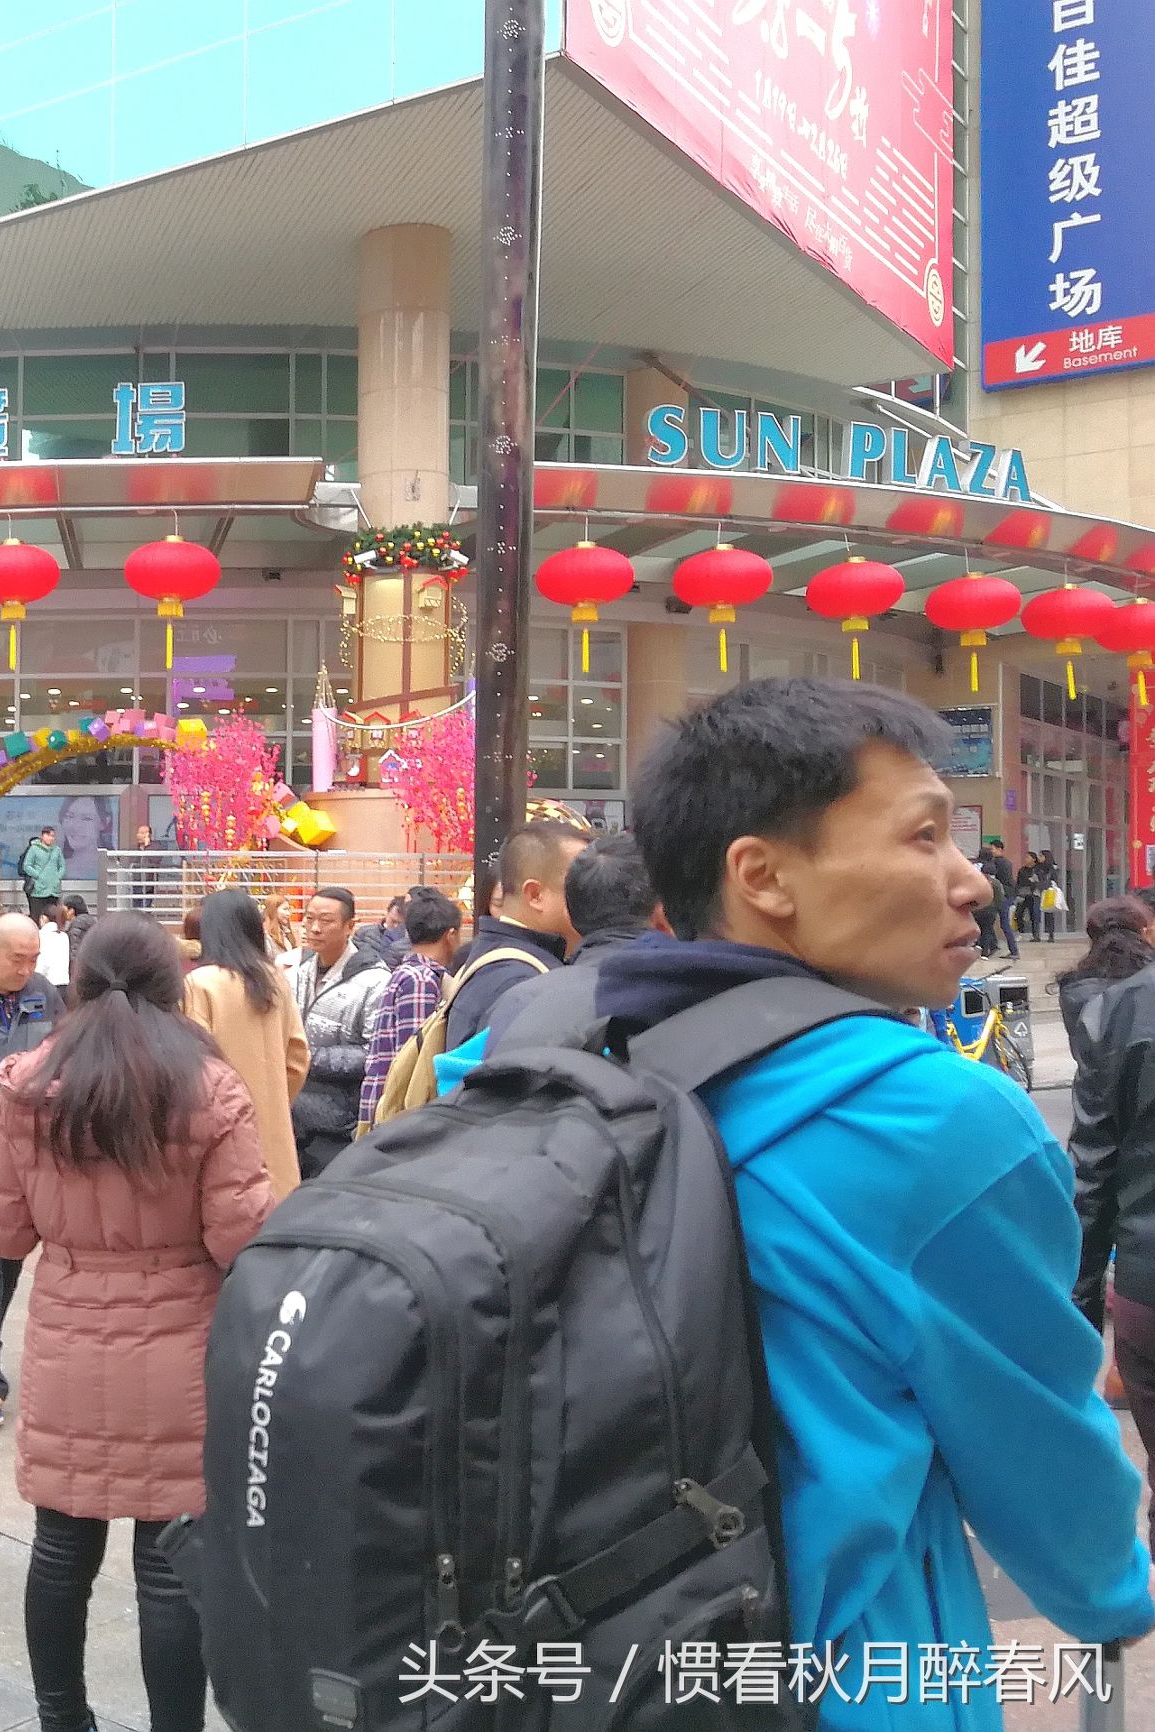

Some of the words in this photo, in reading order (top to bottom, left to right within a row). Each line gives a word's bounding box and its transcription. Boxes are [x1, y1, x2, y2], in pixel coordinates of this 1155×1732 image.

[1069, 325, 1123, 354] 地库
[1063, 346, 1138, 370] Basement
[646, 403, 802, 474] SUN
[848, 420, 1033, 502] PLAZA
